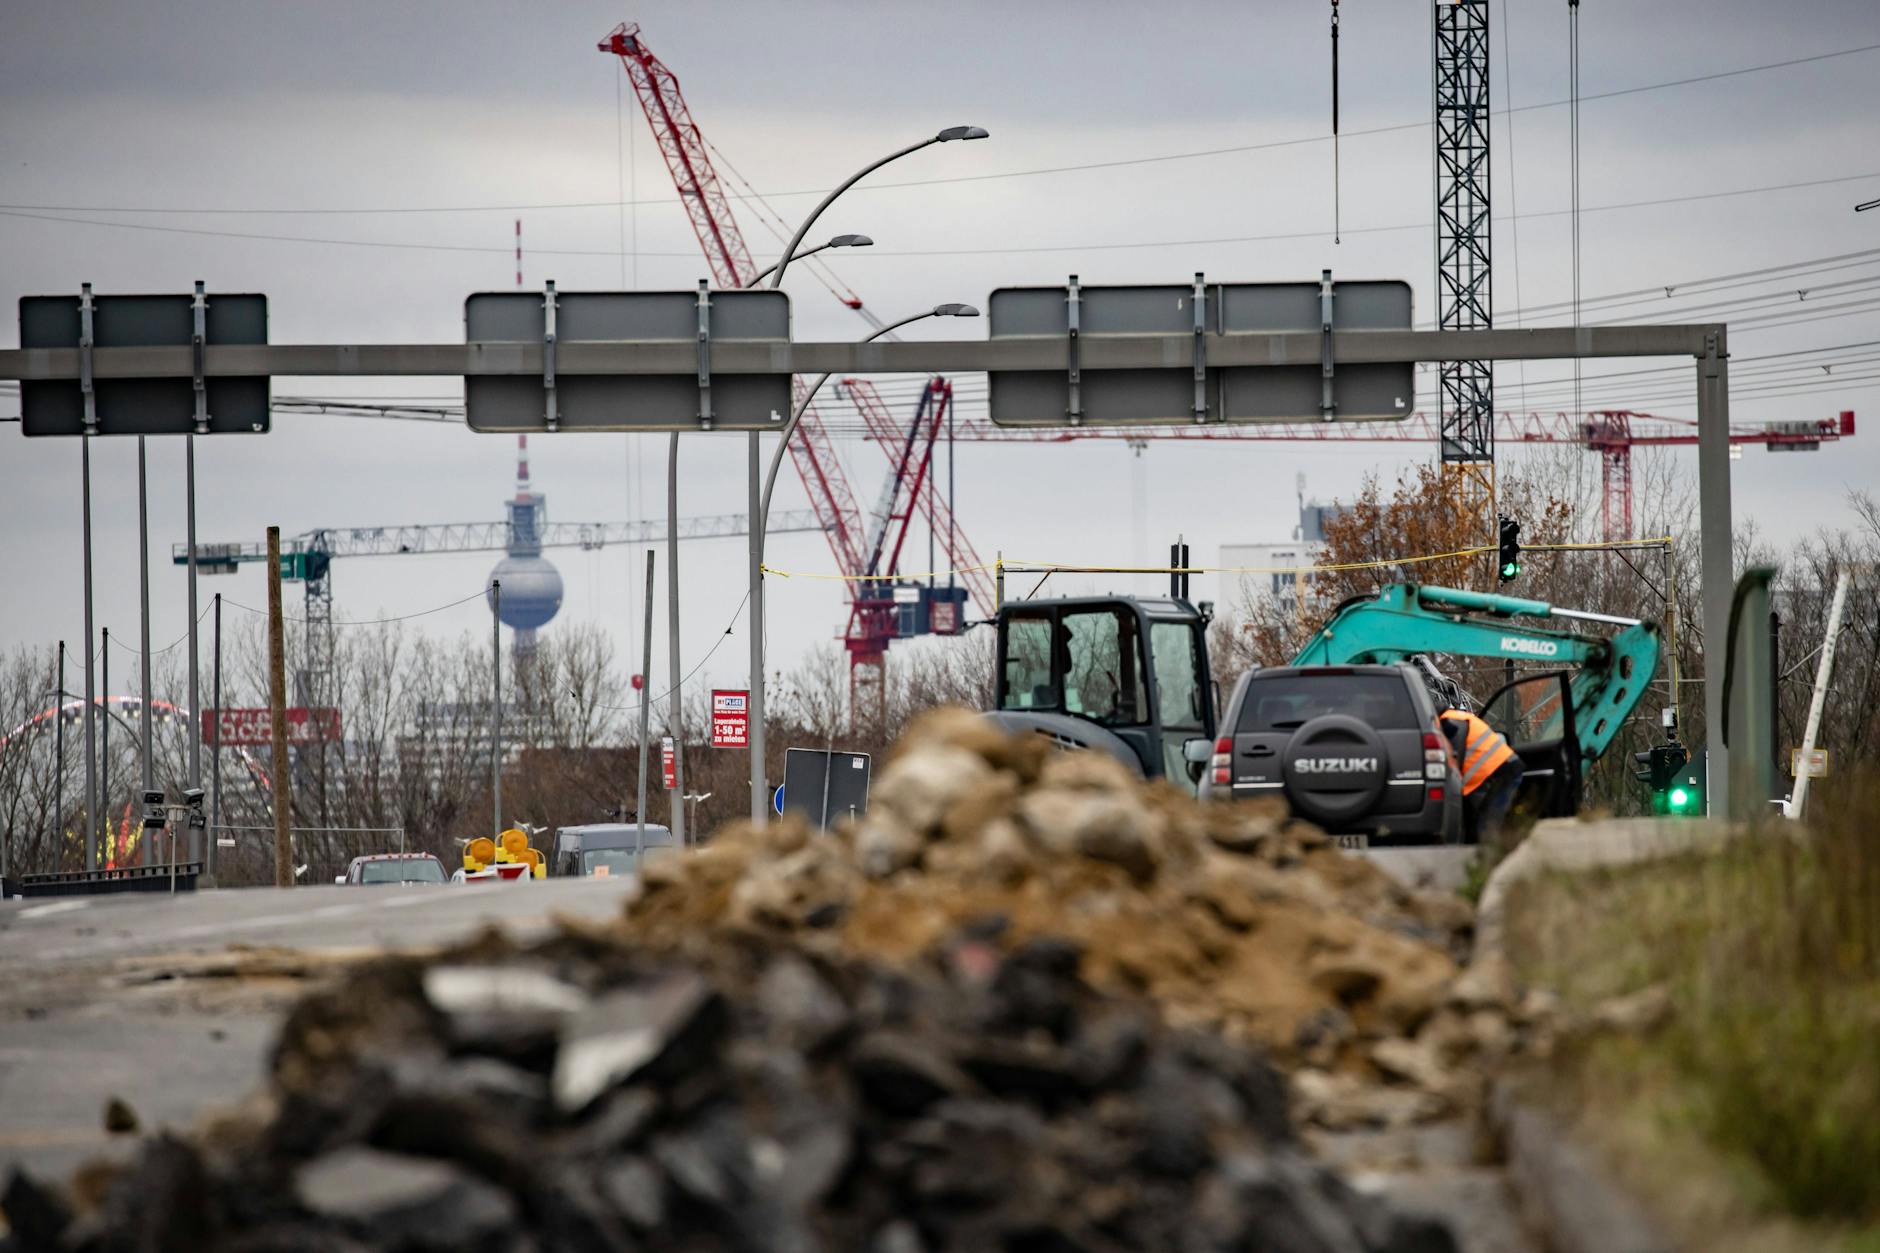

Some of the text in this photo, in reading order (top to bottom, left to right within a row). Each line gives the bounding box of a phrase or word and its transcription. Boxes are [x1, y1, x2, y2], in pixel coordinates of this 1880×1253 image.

[1501, 636, 1557, 656] KOBELCO
[714, 725, 733, 735] 1-50
[1294, 758, 1378, 773] SUZUKI
